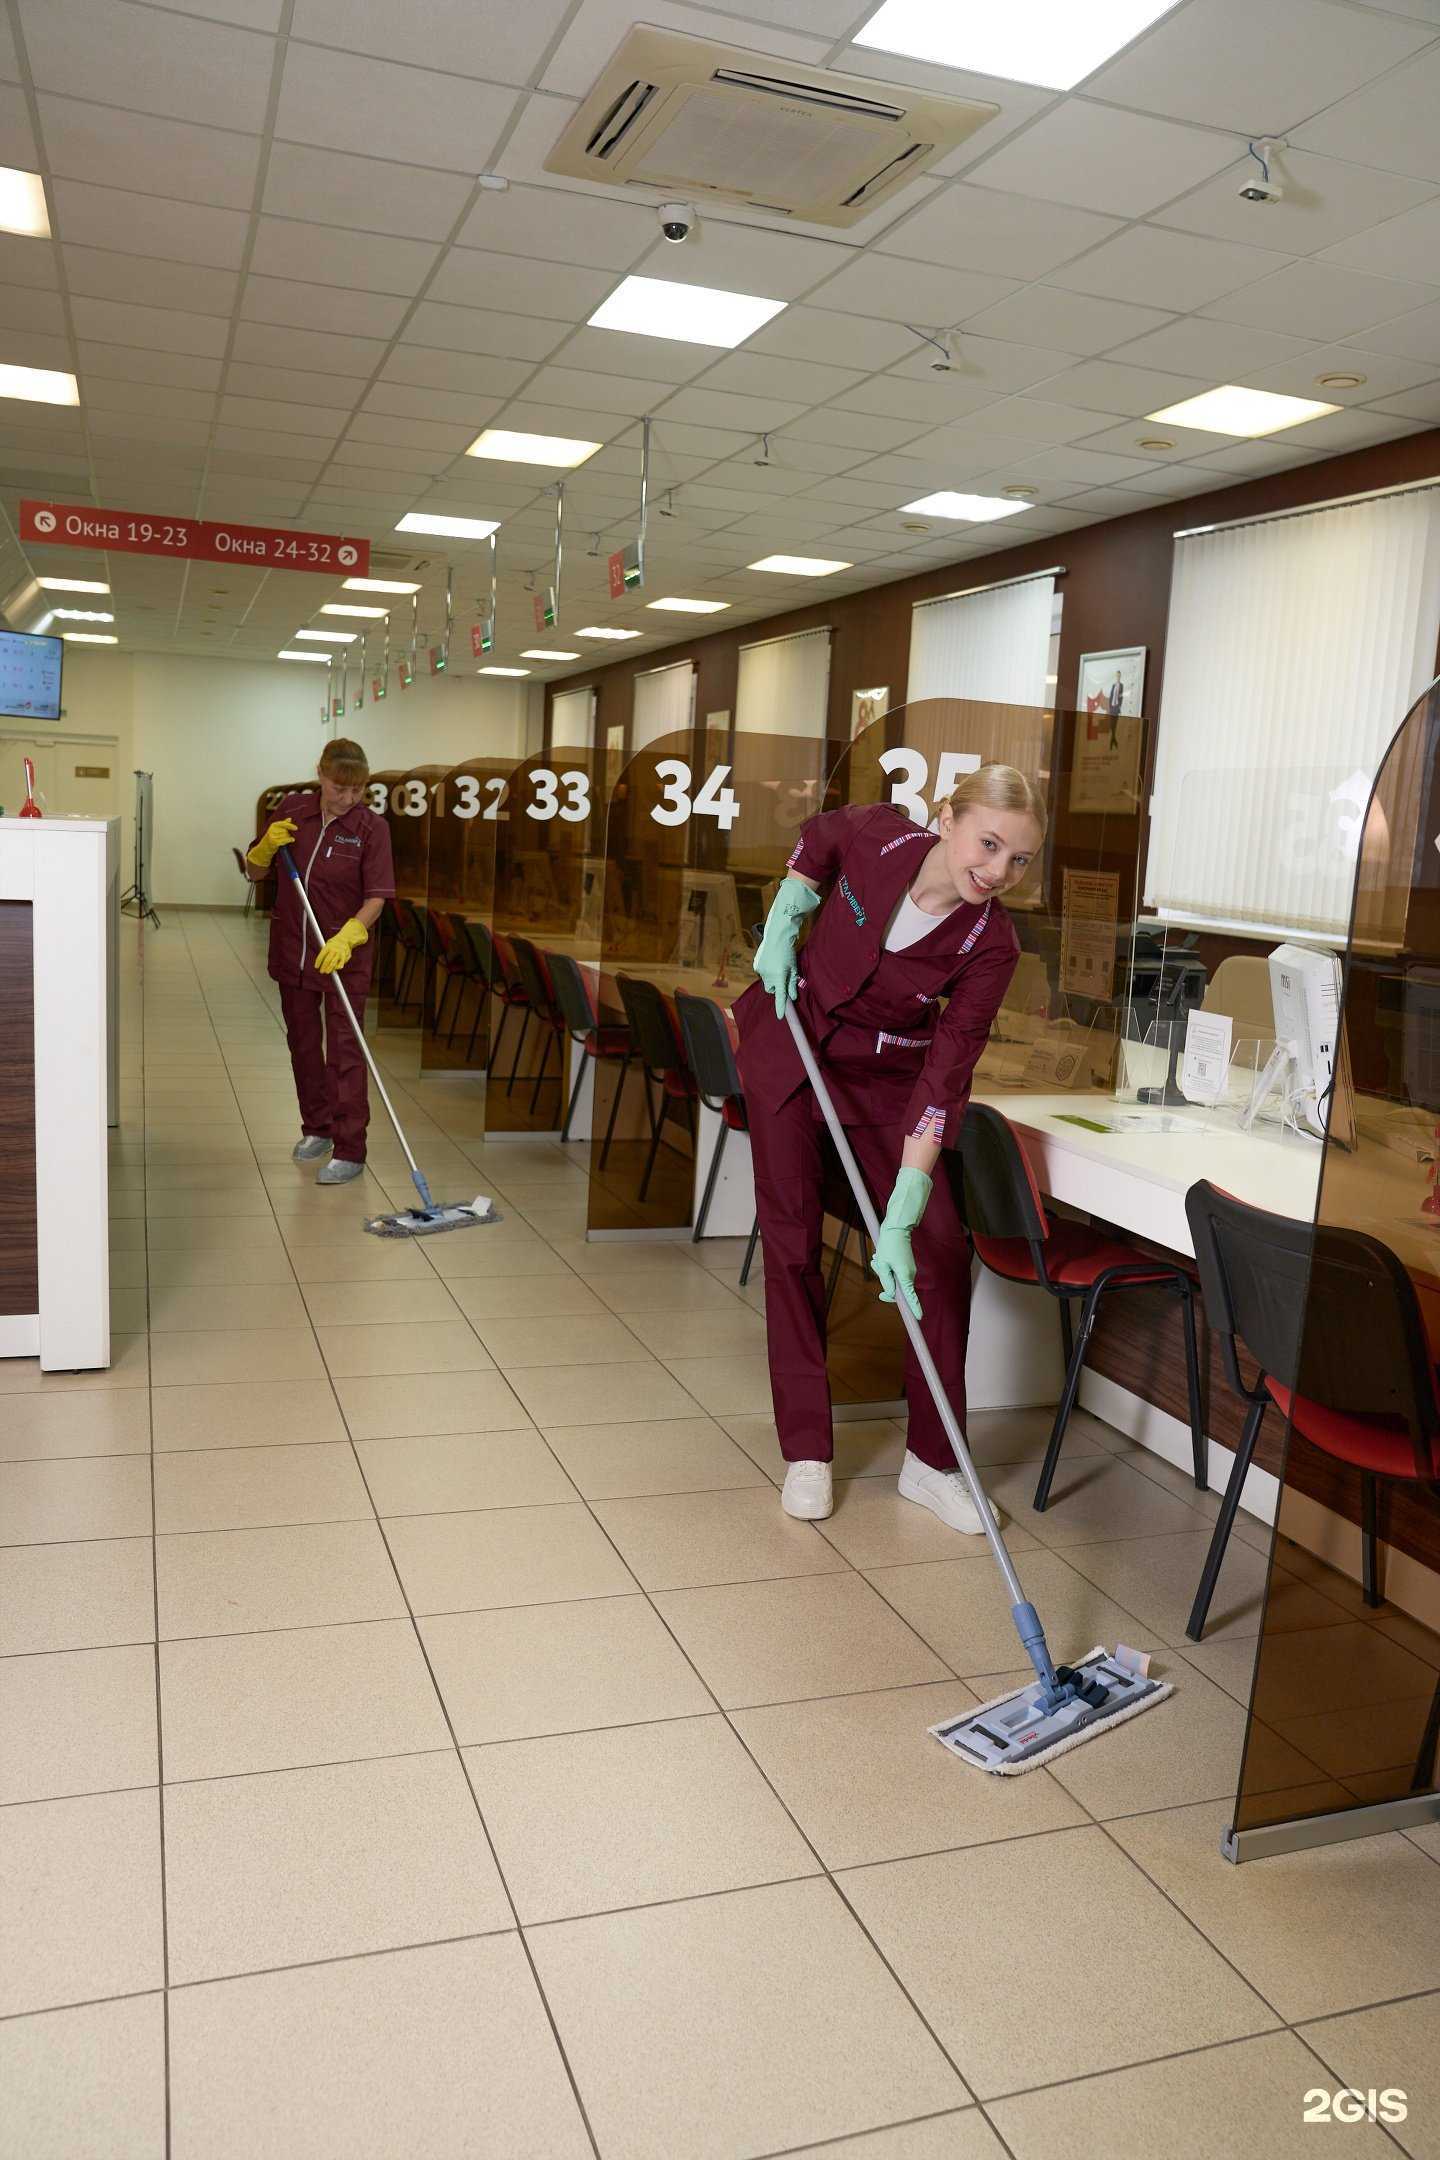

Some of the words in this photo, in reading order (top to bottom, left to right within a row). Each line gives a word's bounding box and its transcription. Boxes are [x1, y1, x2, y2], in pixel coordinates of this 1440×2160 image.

[66, 515, 119, 539] Окна
[127, 522, 188, 547] 19-23
[215, 532, 266, 556] Окна
[273, 539, 331, 563] 24-32
[452, 775, 510, 820] 32
[526, 769, 591, 823] 33
[650, 759, 740, 831] 34
